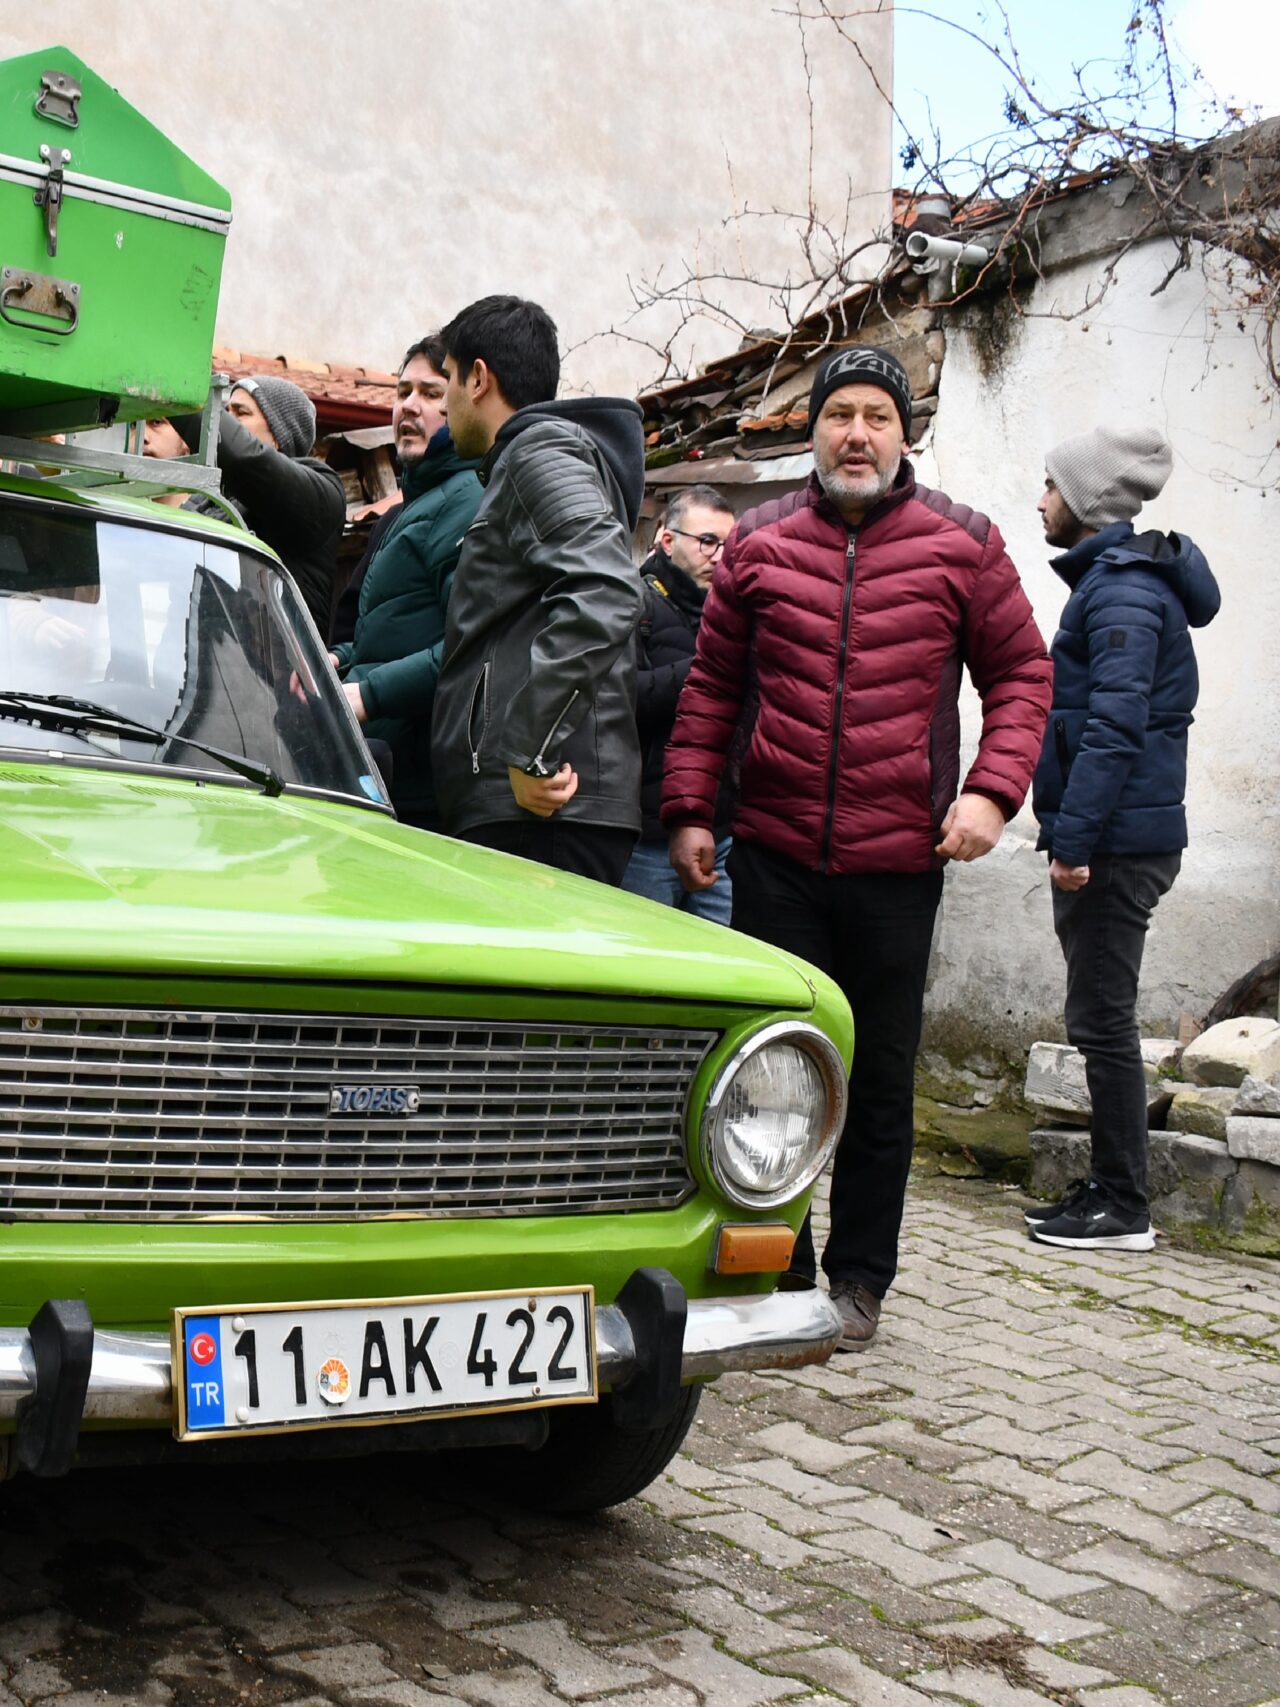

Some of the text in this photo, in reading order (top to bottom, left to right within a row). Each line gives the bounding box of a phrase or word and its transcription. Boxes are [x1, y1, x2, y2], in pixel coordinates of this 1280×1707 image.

[235, 1306, 577, 1408] 11 AK 422
[191, 1382, 220, 1407] TR
